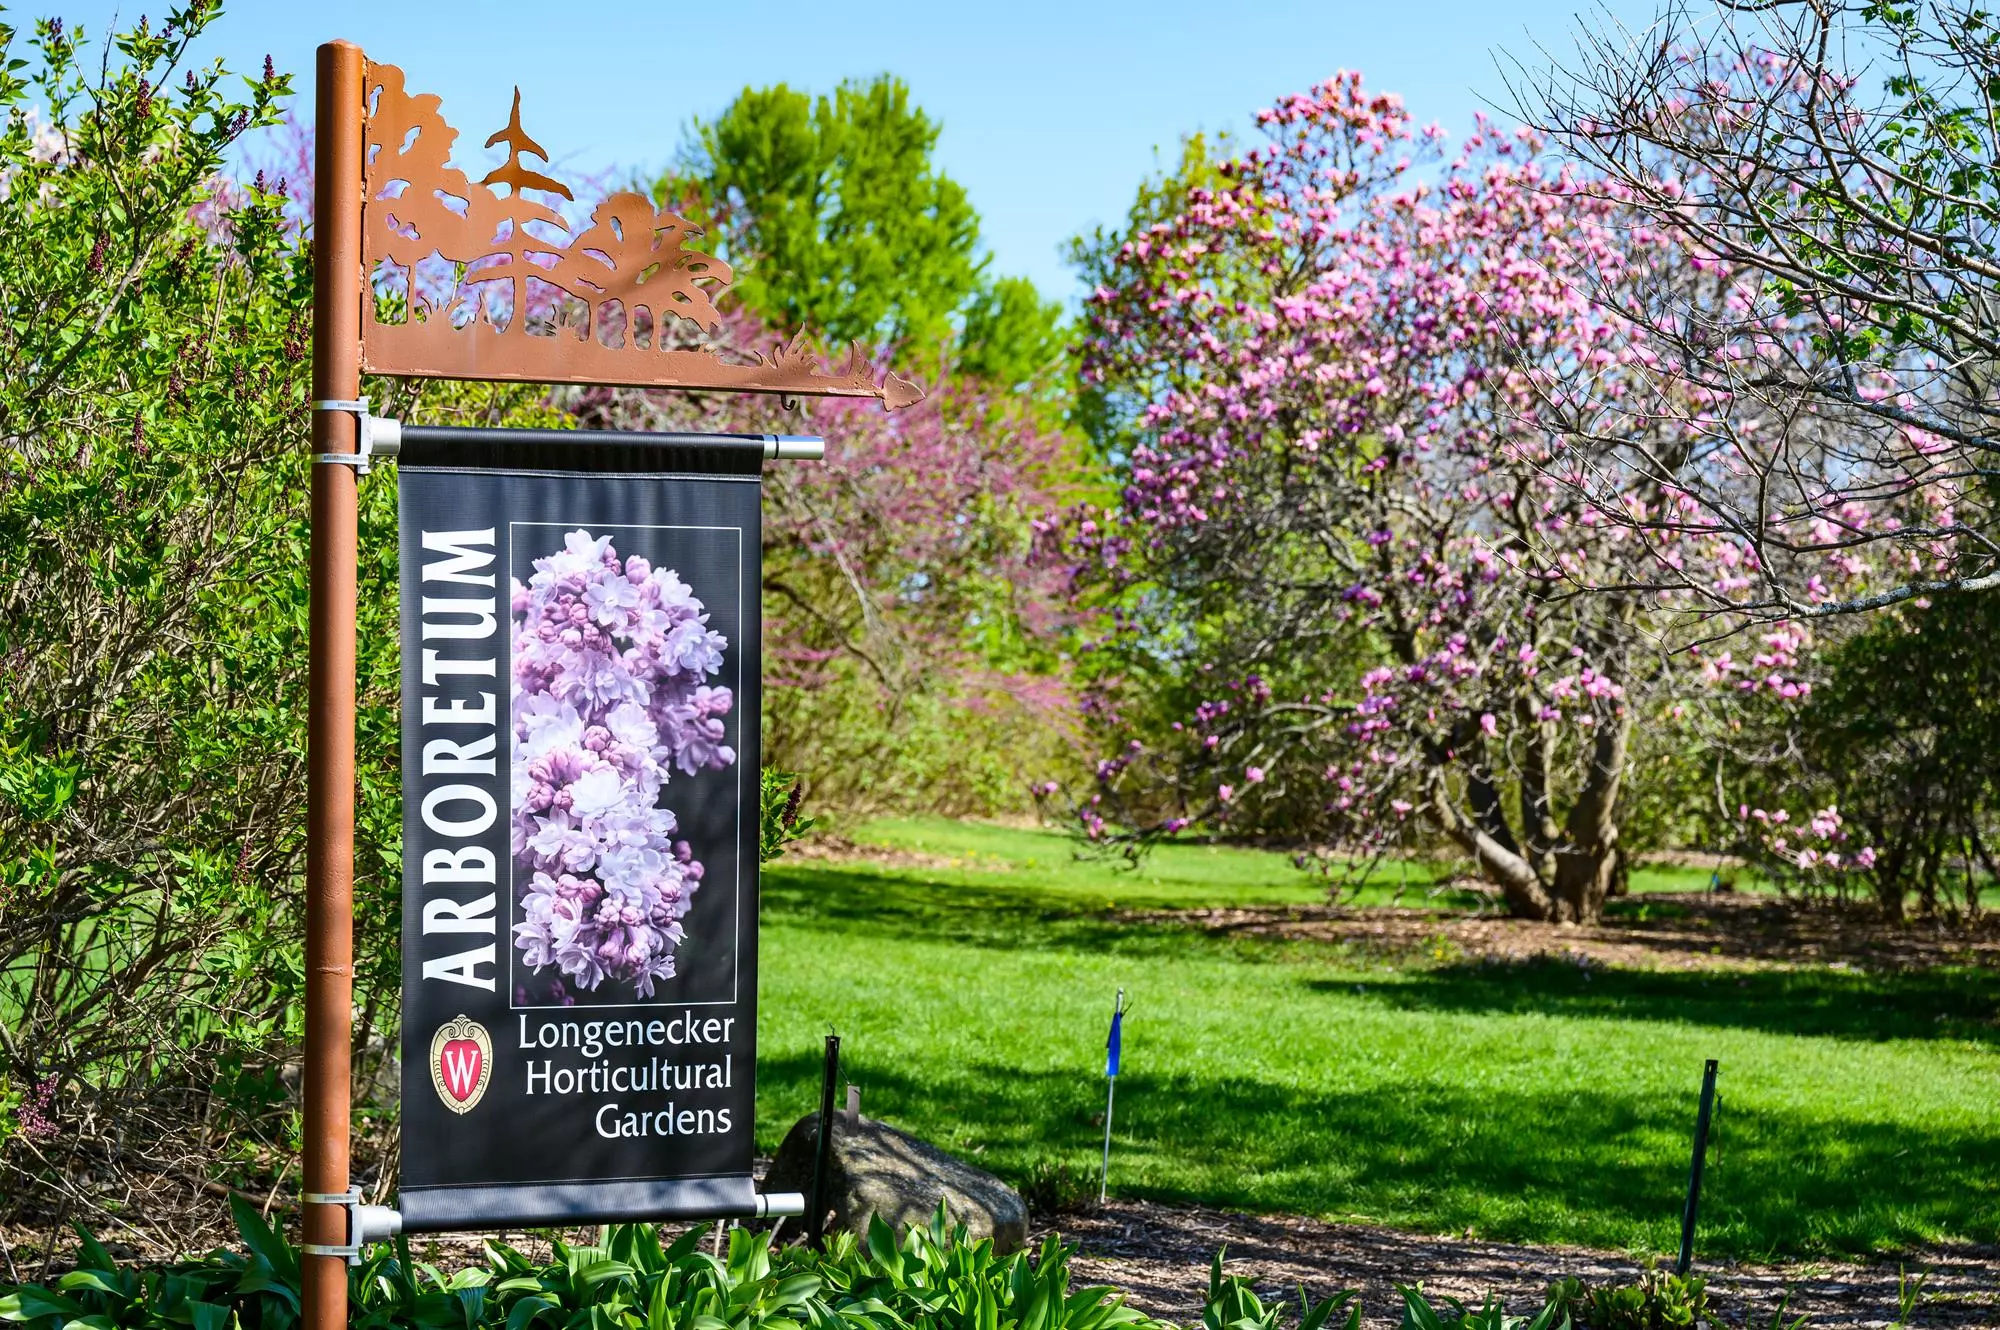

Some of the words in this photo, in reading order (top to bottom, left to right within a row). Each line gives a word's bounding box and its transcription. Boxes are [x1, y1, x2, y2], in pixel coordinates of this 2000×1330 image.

[421, 527, 498, 993] ARBORETUM
[518, 1010, 736, 1058] Longenecker
[445, 1049, 478, 1094] W
[525, 1055, 732, 1095] Horticultural
[595, 1102, 733, 1139] Gardens
